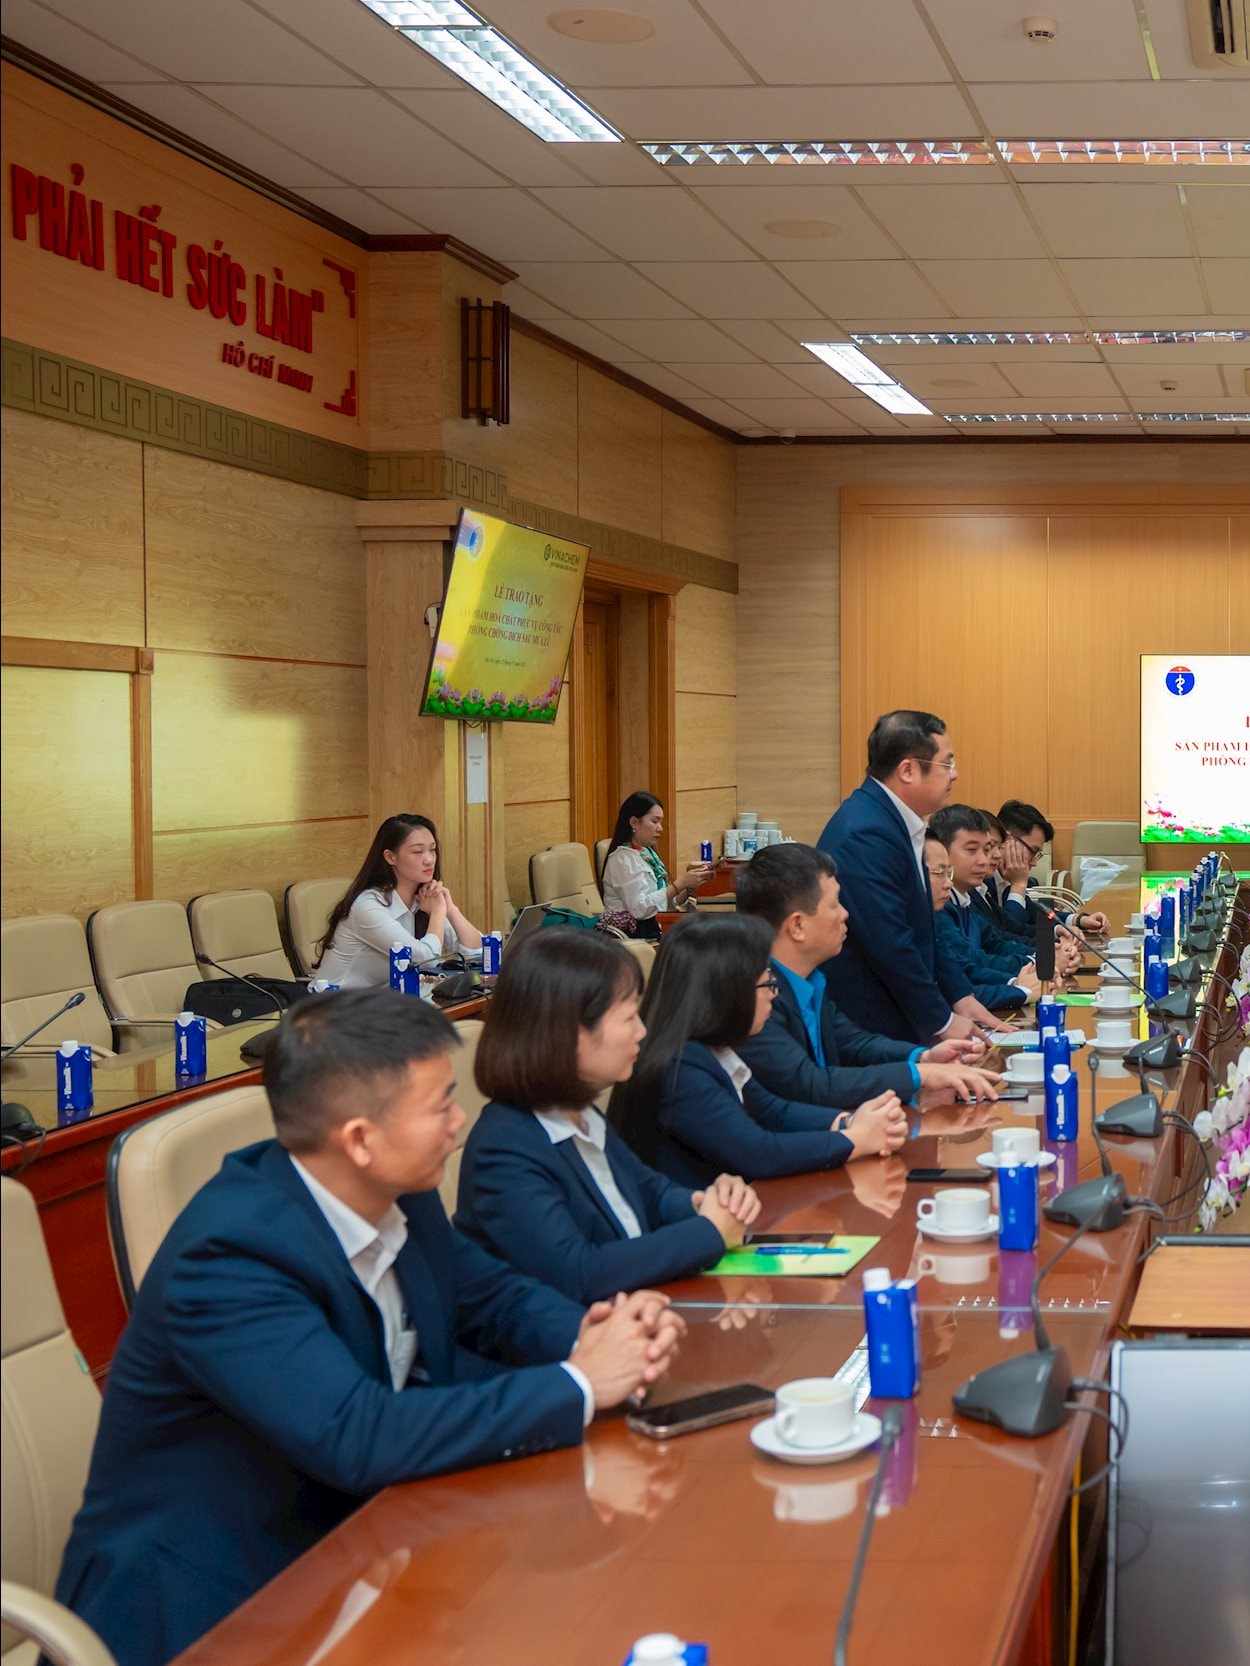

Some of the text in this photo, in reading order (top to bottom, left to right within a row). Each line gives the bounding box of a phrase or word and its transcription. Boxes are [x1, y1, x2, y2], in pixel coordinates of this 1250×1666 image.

[11, 163, 104, 271] PHẢI
[114, 204, 177, 298] HẾT
[186, 239, 247, 326] SỨC
[247, 352, 276, 379] CHÍ
